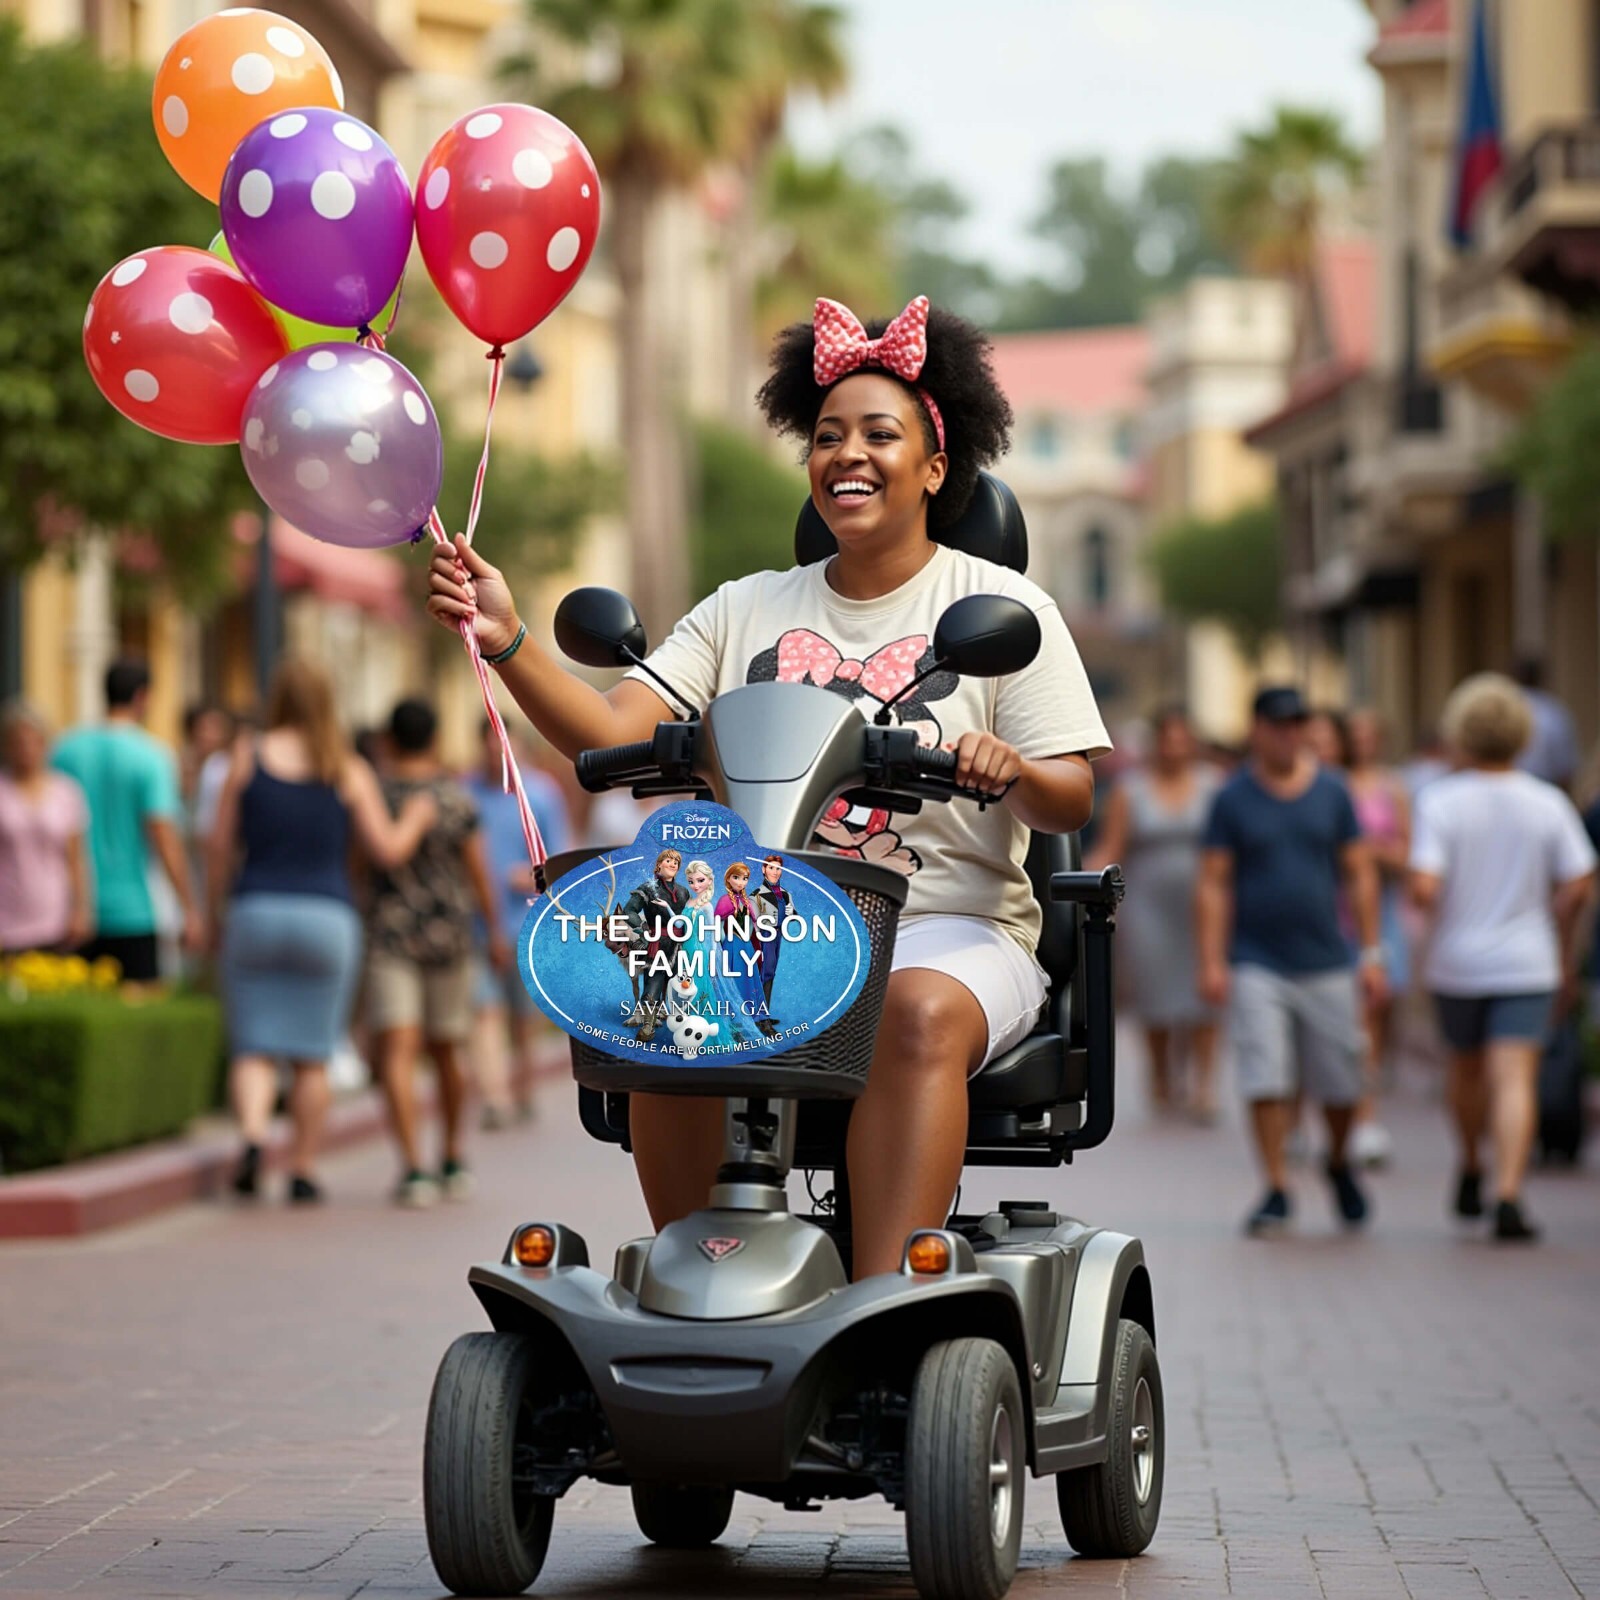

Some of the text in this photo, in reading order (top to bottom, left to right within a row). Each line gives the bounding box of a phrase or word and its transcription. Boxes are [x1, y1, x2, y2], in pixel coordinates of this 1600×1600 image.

[662, 824, 730, 841] FROZEN
[553, 914, 836, 943] THE JOHNSON
[628, 949, 764, 978] FAMILY
[620, 1000, 771, 1019] SAVANNAH, GA
[576, 1021, 810, 1055] SOME PEOPLE ARE WORTH MELTING FOR
